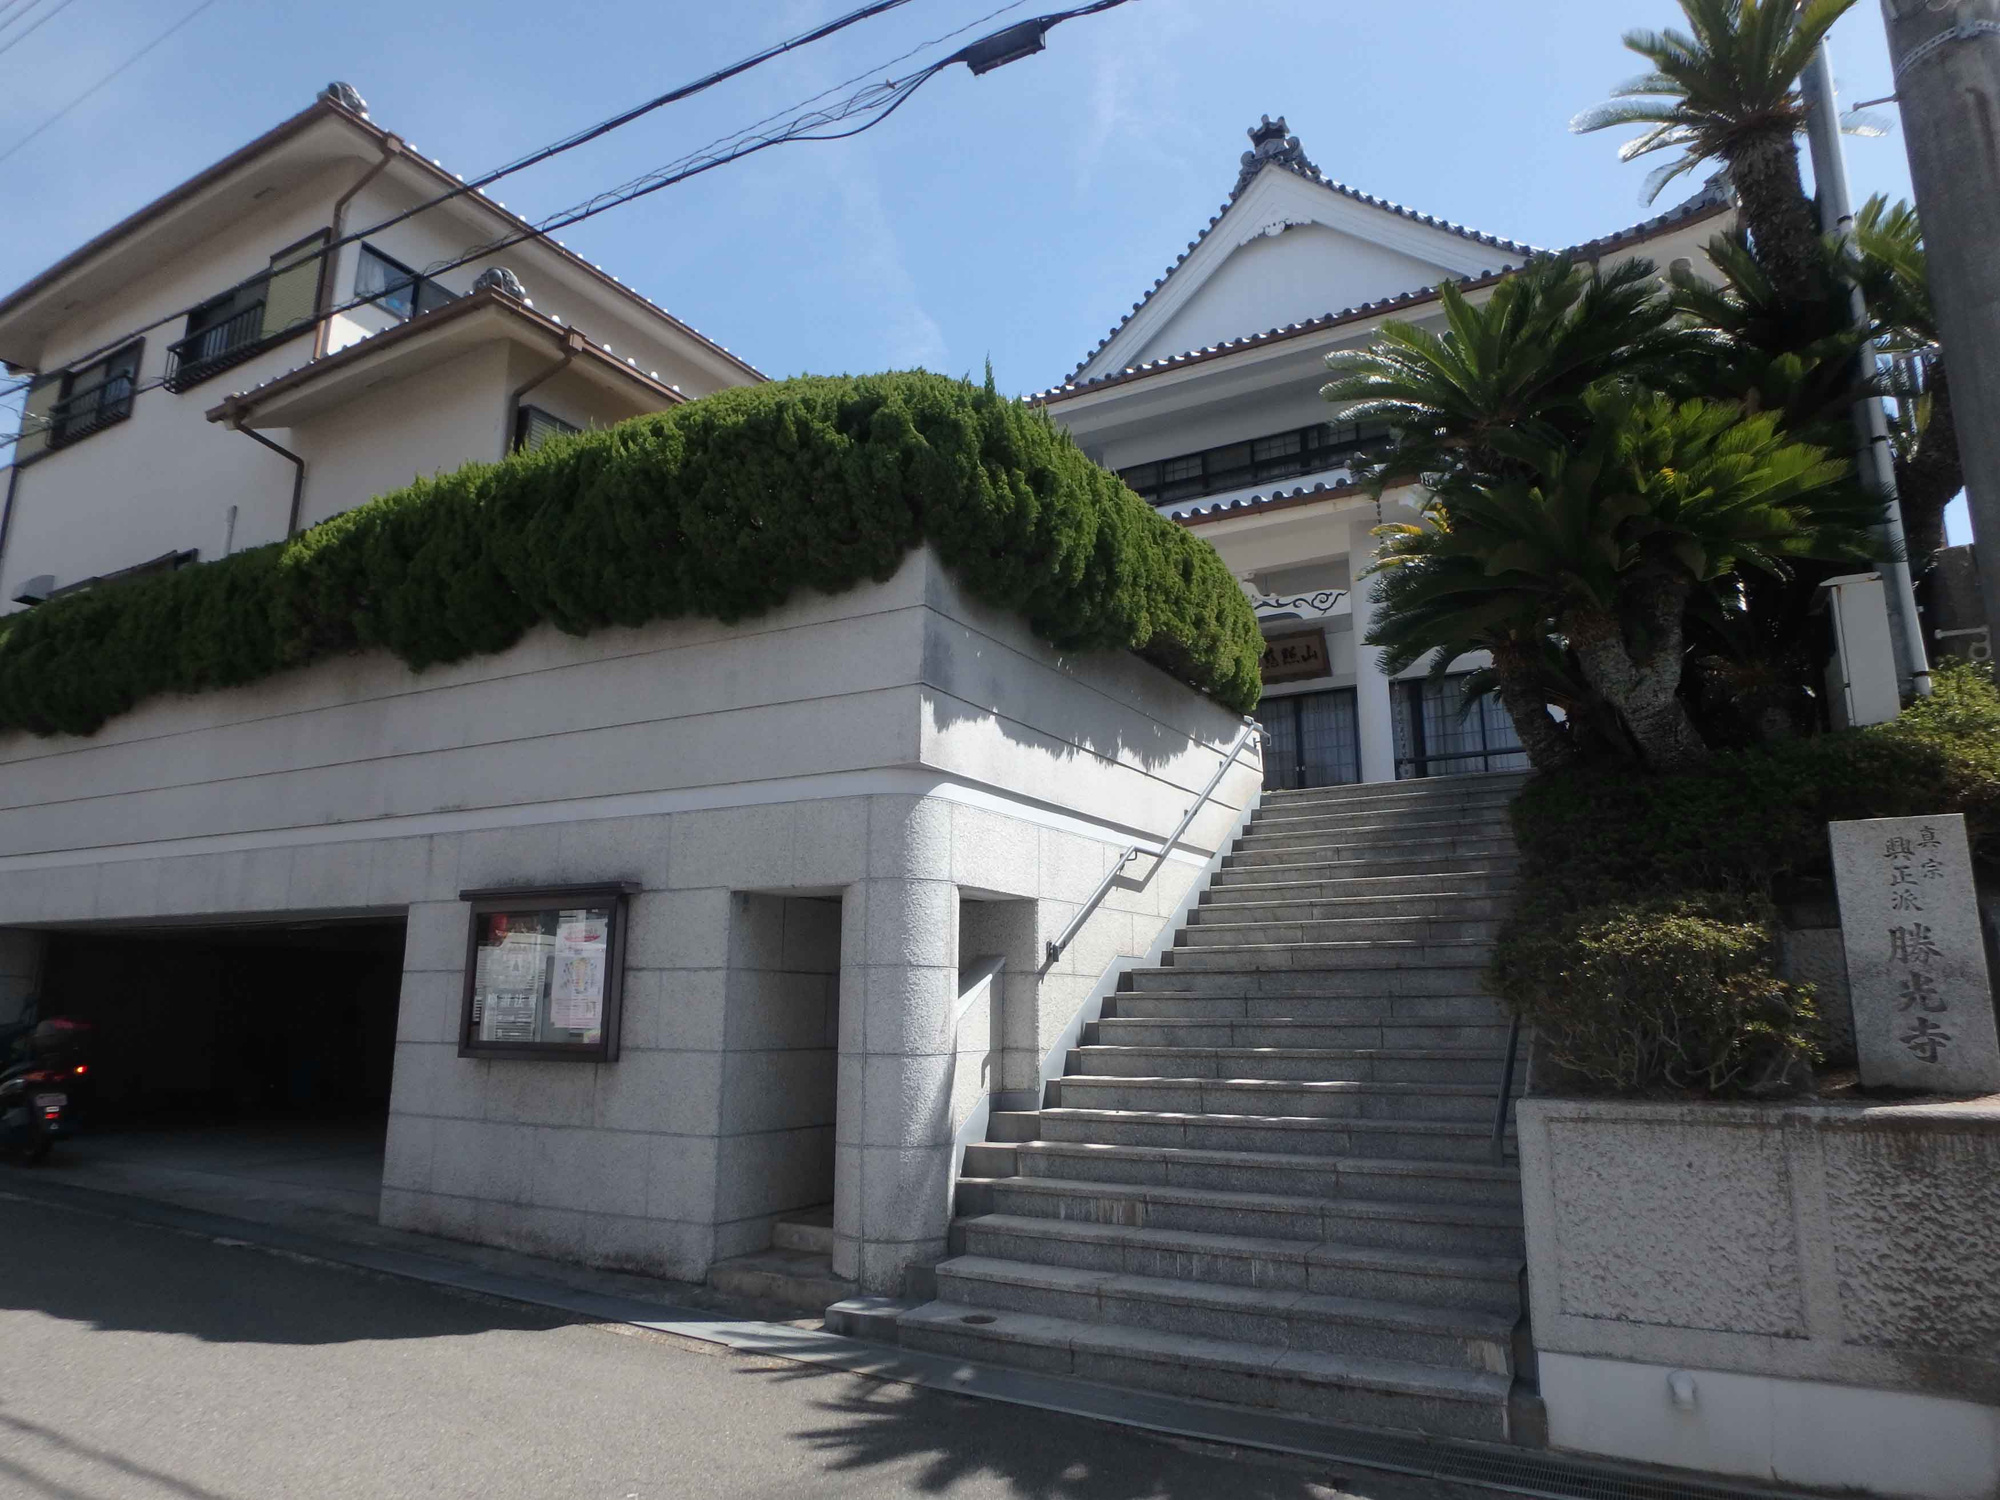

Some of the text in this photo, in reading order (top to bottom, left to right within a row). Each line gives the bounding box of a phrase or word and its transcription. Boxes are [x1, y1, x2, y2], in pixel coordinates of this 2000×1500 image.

[1883, 836, 1924, 912] 興正派
[1916, 825, 1944, 880] 真宗
[1887, 921, 1951, 1064] 勝光寺
